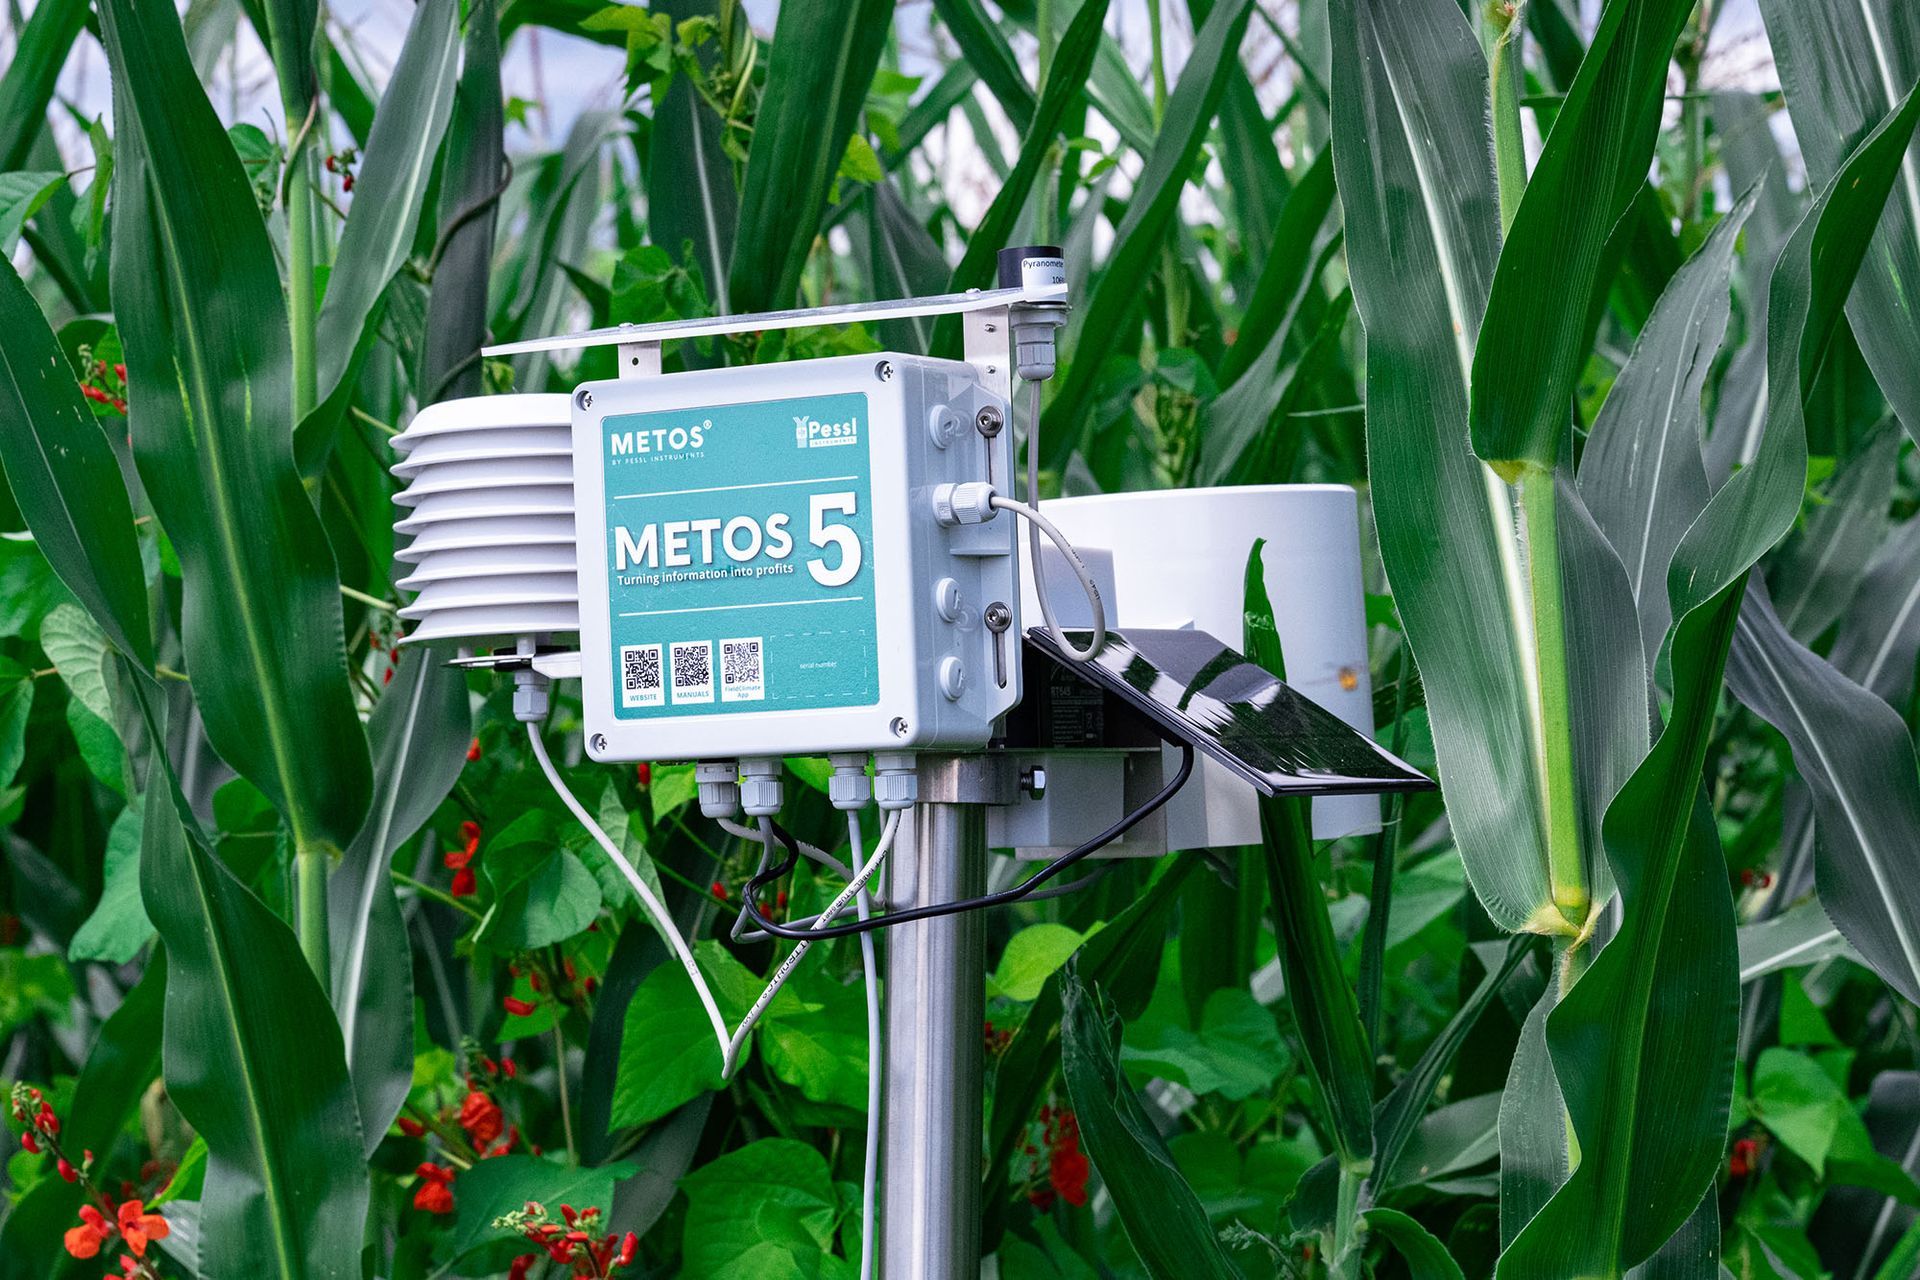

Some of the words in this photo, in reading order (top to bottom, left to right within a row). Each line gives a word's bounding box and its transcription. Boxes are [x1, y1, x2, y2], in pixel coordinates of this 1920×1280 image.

[808, 417, 857, 438] Pessl
[611, 458, 621, 466] BY
[625, 456, 647, 464] PESSL
[650, 451, 705, 462] INSTRUMENTS
[614, 513, 793, 571] METOS
[806, 491, 863, 587] 5
[617, 574, 660, 587] Turning
[662, 569, 728, 583] information
[730, 566, 753, 578] into
[756, 563, 794, 577] profits
[676, 690, 710, 699] MANUALS
[724, 684, 761, 692] FieldClimate
[629, 693, 657, 702] WEBSITE
